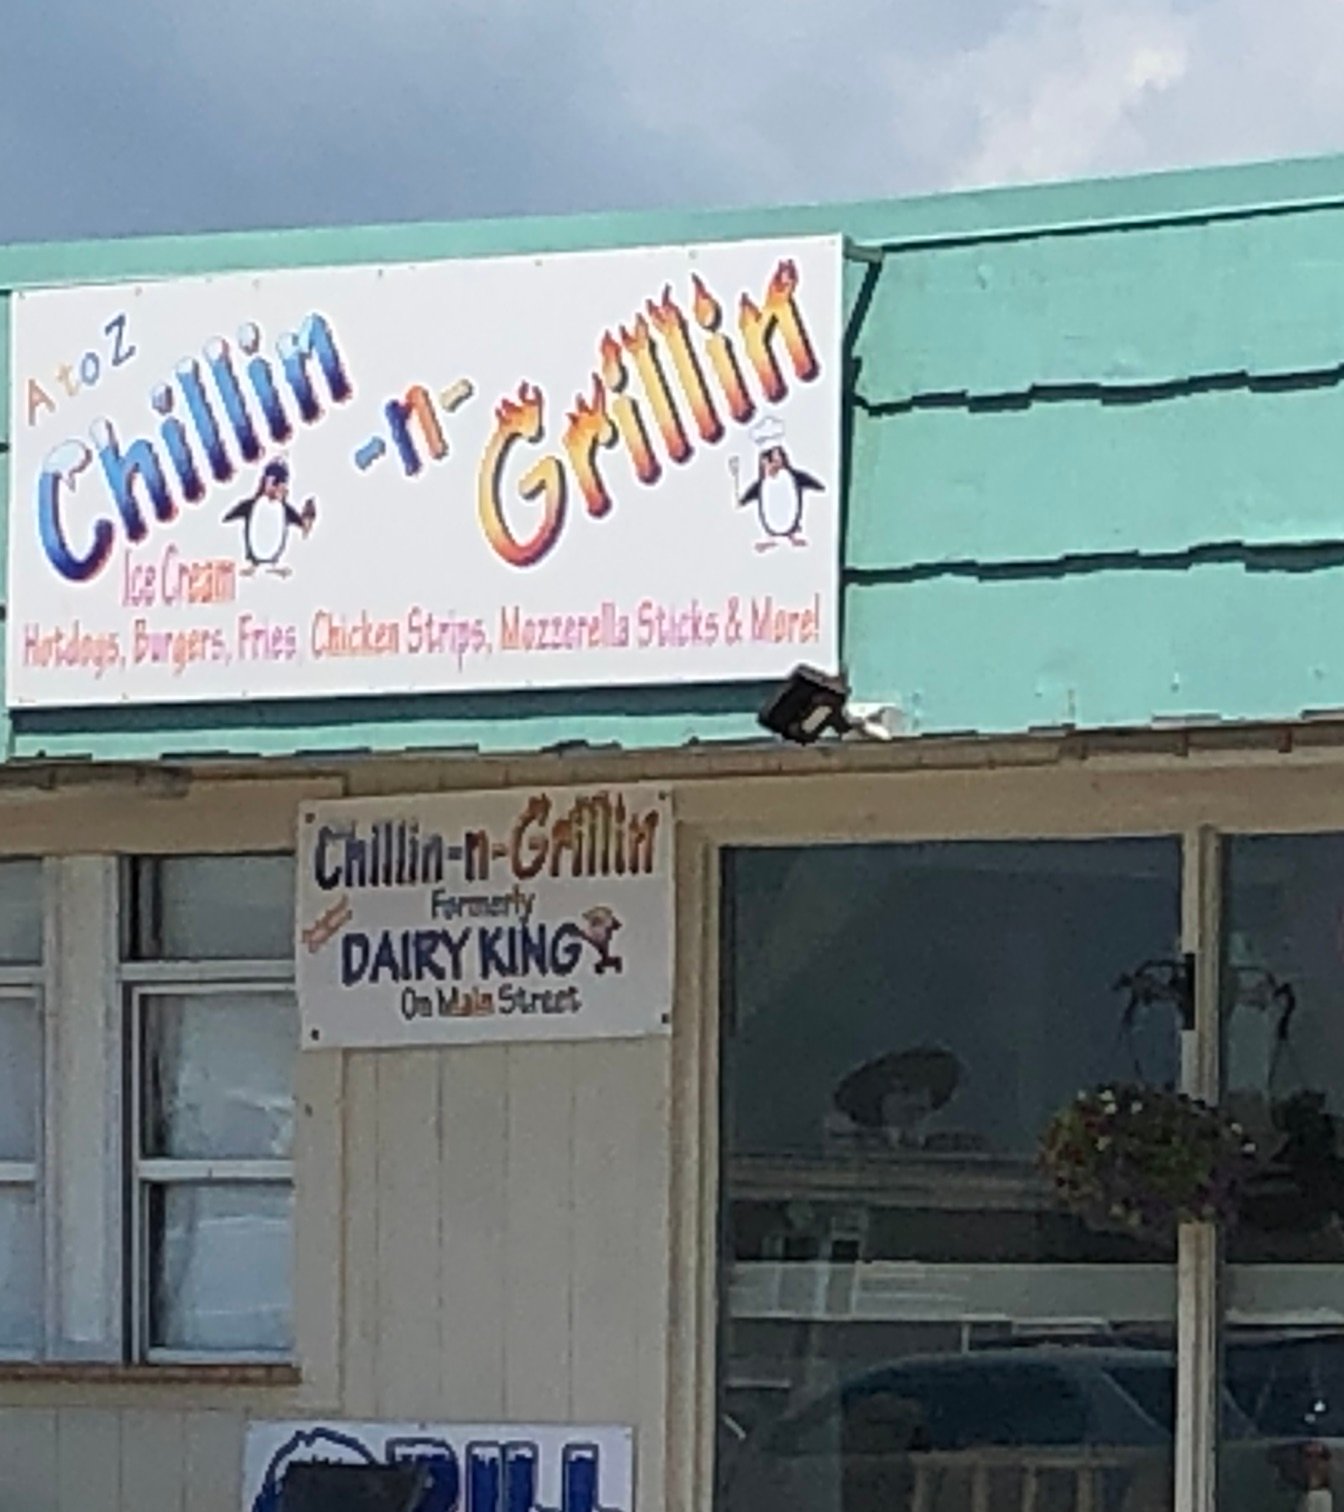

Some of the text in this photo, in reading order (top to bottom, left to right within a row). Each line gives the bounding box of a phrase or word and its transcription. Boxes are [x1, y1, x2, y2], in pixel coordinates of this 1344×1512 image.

[28, 314, 136, 426] A to Z
[38, 312, 352, 582] Chillin
[478, 258, 821, 567] Grillin
[123, 544, 237, 606] Ice Cream
[23, 620, 125, 678] Hotdogs,
[134, 618, 230, 676] Burgers,
[311, 609, 400, 655] Chicken
[407, 605, 493, 672] Strips,
[637, 599, 718, 648] Sticks
[725, 595, 742, 646] &
[751, 593, 820, 645] More!
[431, 887, 536, 924] Formerly
[340, 923, 584, 988] DAIRY KING
[401, 983, 583, 1020] On Main Street
